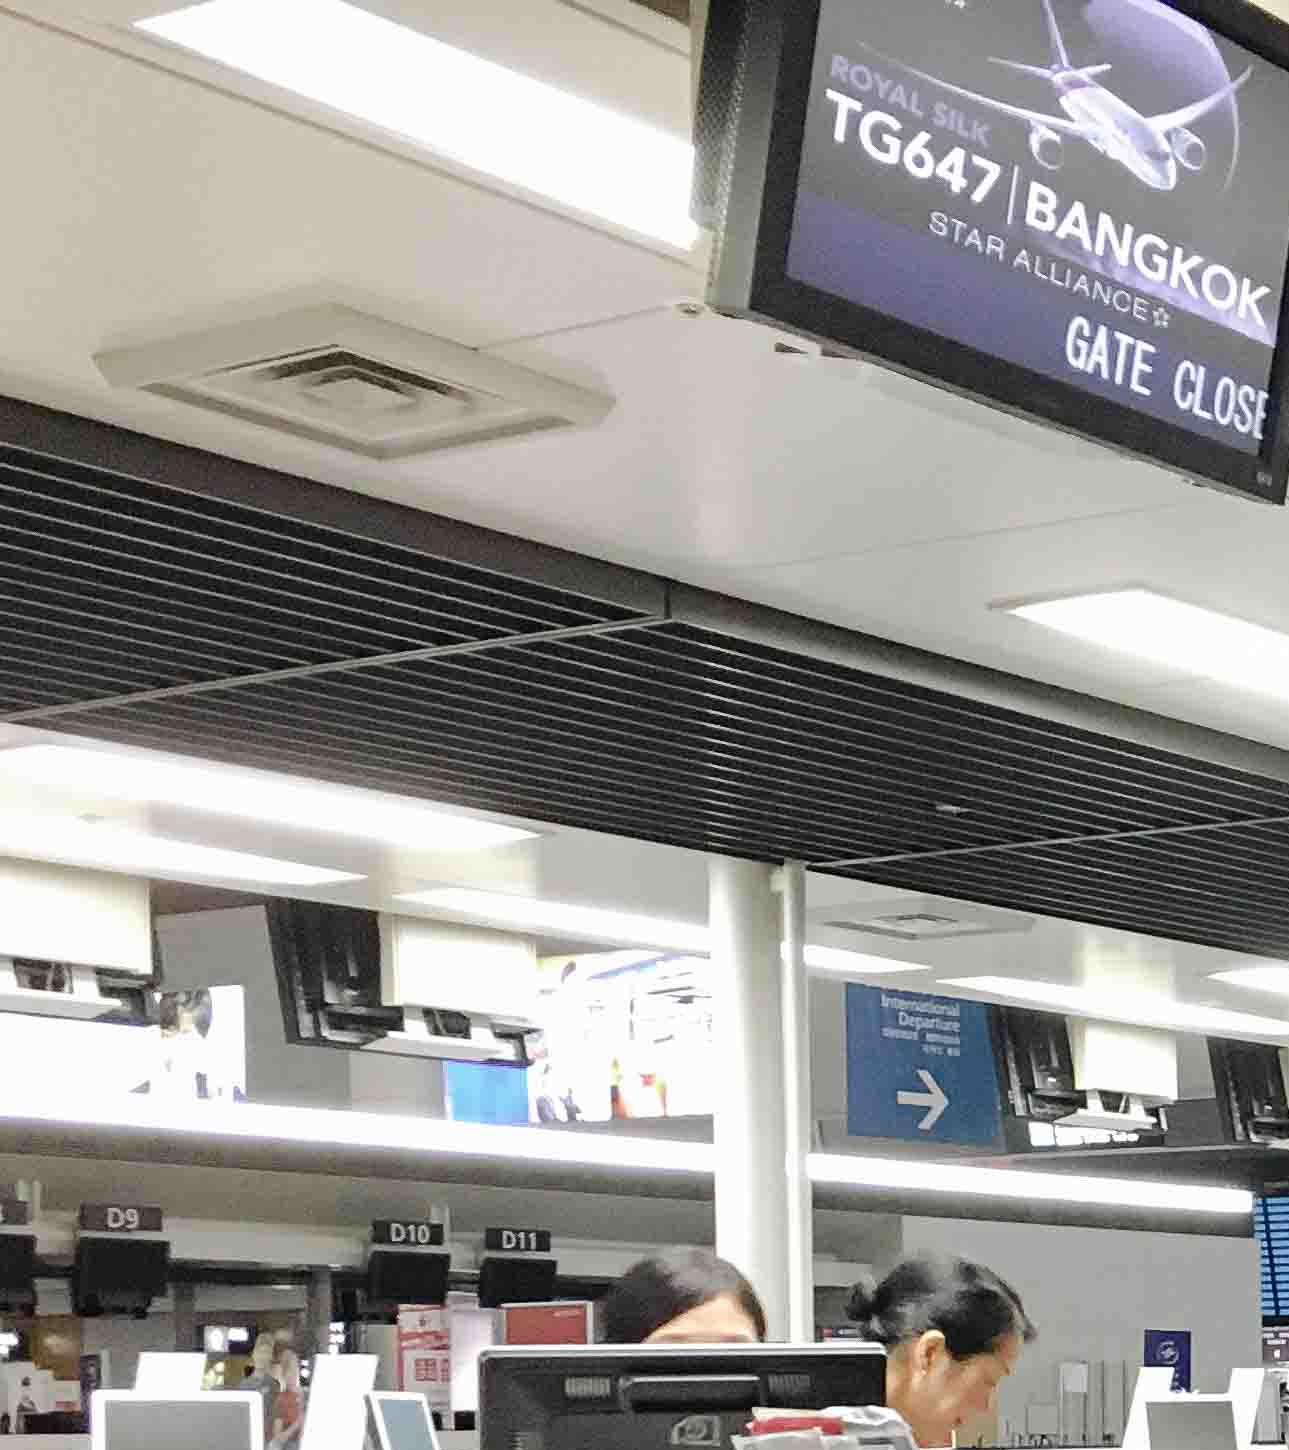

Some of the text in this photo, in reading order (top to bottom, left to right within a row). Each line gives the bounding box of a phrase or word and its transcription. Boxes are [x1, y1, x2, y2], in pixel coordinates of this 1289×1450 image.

[831, 53, 994, 147] ROYAL SILK
[825, 87, 1273, 330] TG647 BANGKOK
[927, 210, 1153, 322] STAR ALLIANCE
[1064, 315, 1157, 397] GATE
[106, 1207, 141, 1229] D9
[390, 1223, 431, 1244] D10
[501, 1230, 537, 1250] D11
